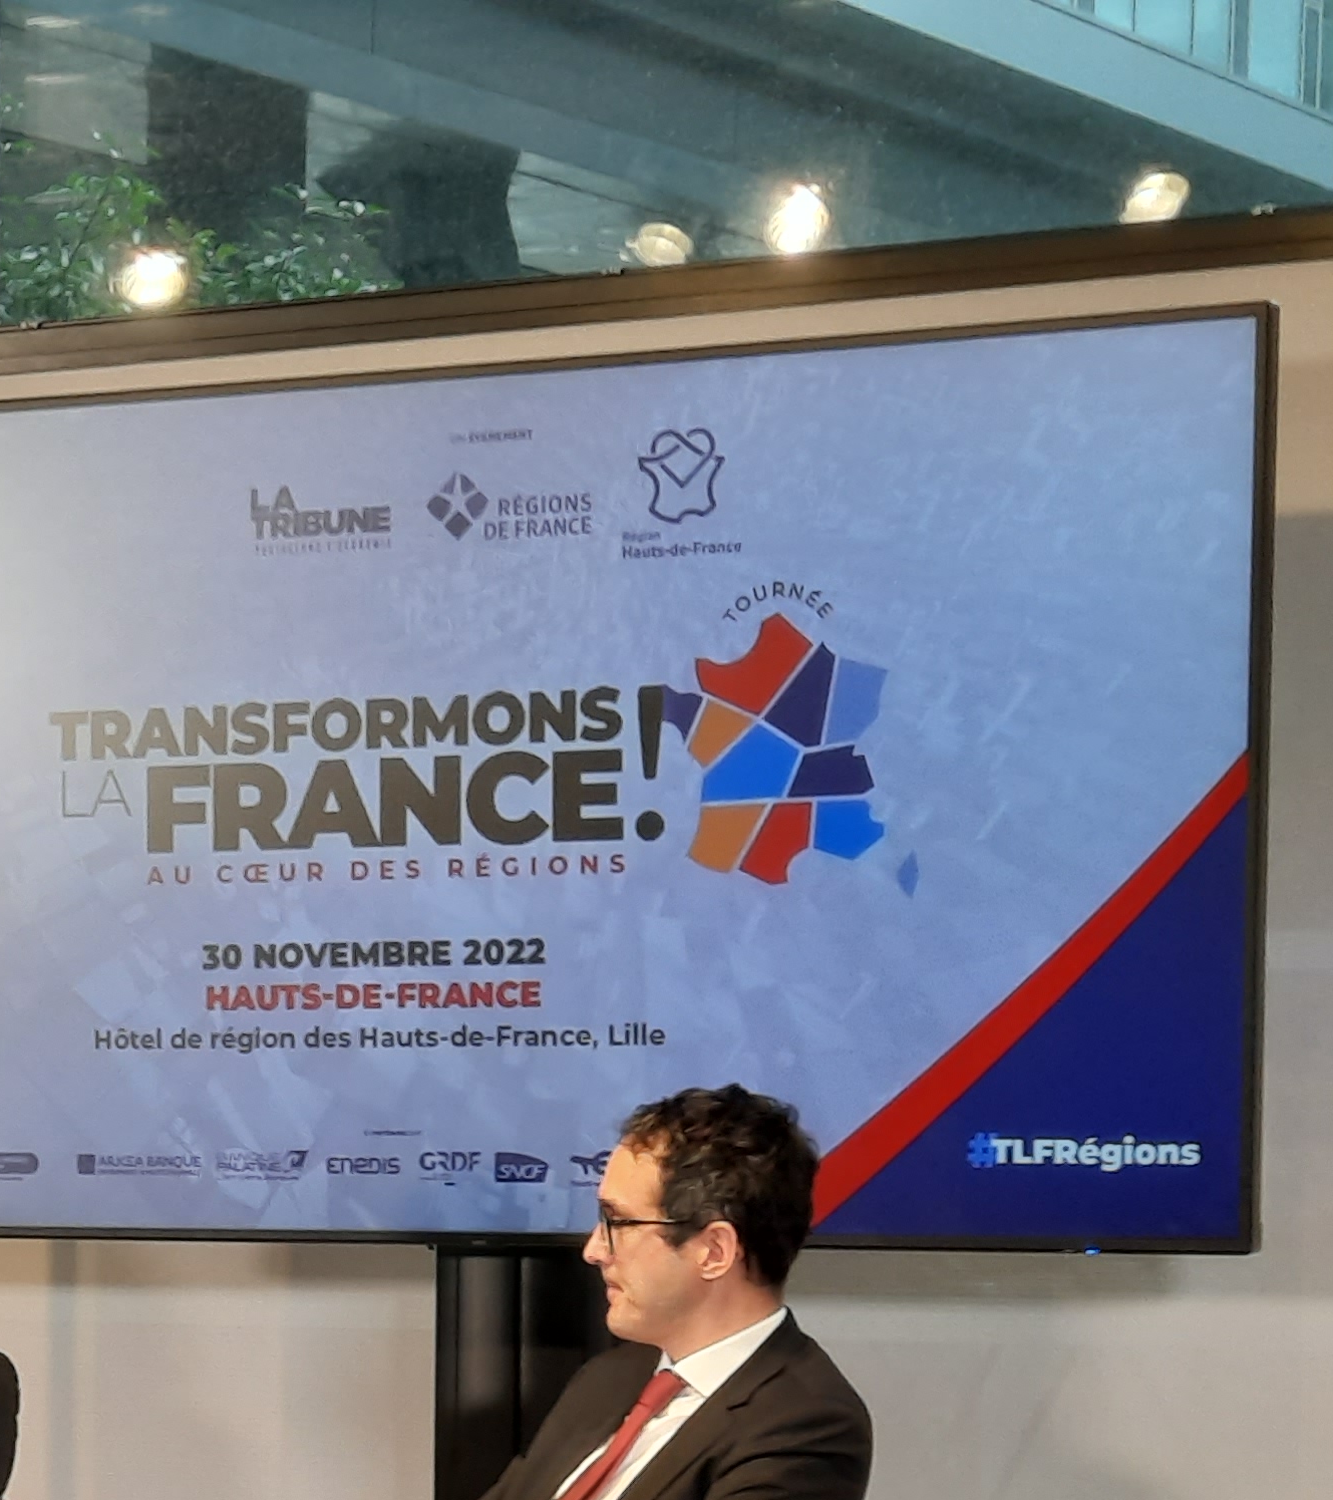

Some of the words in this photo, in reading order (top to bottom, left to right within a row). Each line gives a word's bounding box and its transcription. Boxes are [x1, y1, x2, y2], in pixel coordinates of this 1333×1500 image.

[250, 485, 297, 511] LA
[497, 492, 593, 517] RÉGIONS
[251, 505, 391, 540] TRIBUNE
[484, 519, 511, 541] DE
[514, 516, 593, 538] FRANCE
[722, 581, 834, 622] TOURNÉE
[49, 686, 623, 761] TRANSFORMONS
[62, 769, 133, 818] LA
[147, 866, 191, 886] AU
[217, 862, 325, 884] CŒUR
[350, 859, 421, 882] DES
[448, 853, 627, 879] RÉGIONS
[202, 943, 242, 970] 30
[253, 940, 451, 969] NOVEMBRE
[463, 938, 546, 966] 2022
[205, 980, 542, 1010] HAUTS-DE-FRANCE
[94, 1027, 162, 1050] Hôtel
[171, 1028, 202, 1049] de
[211, 1026, 296, 1054] région
[303, 1026, 352, 1048] des
[359, 1024, 599, 1051] Hauts-de-France,
[608, 1022, 666, 1046] Lille
[419, 1152, 482, 1171] GRDF
[966, 1131, 1201, 1173] #TLFRégions
[497, 1164, 546, 1179] SNCF
